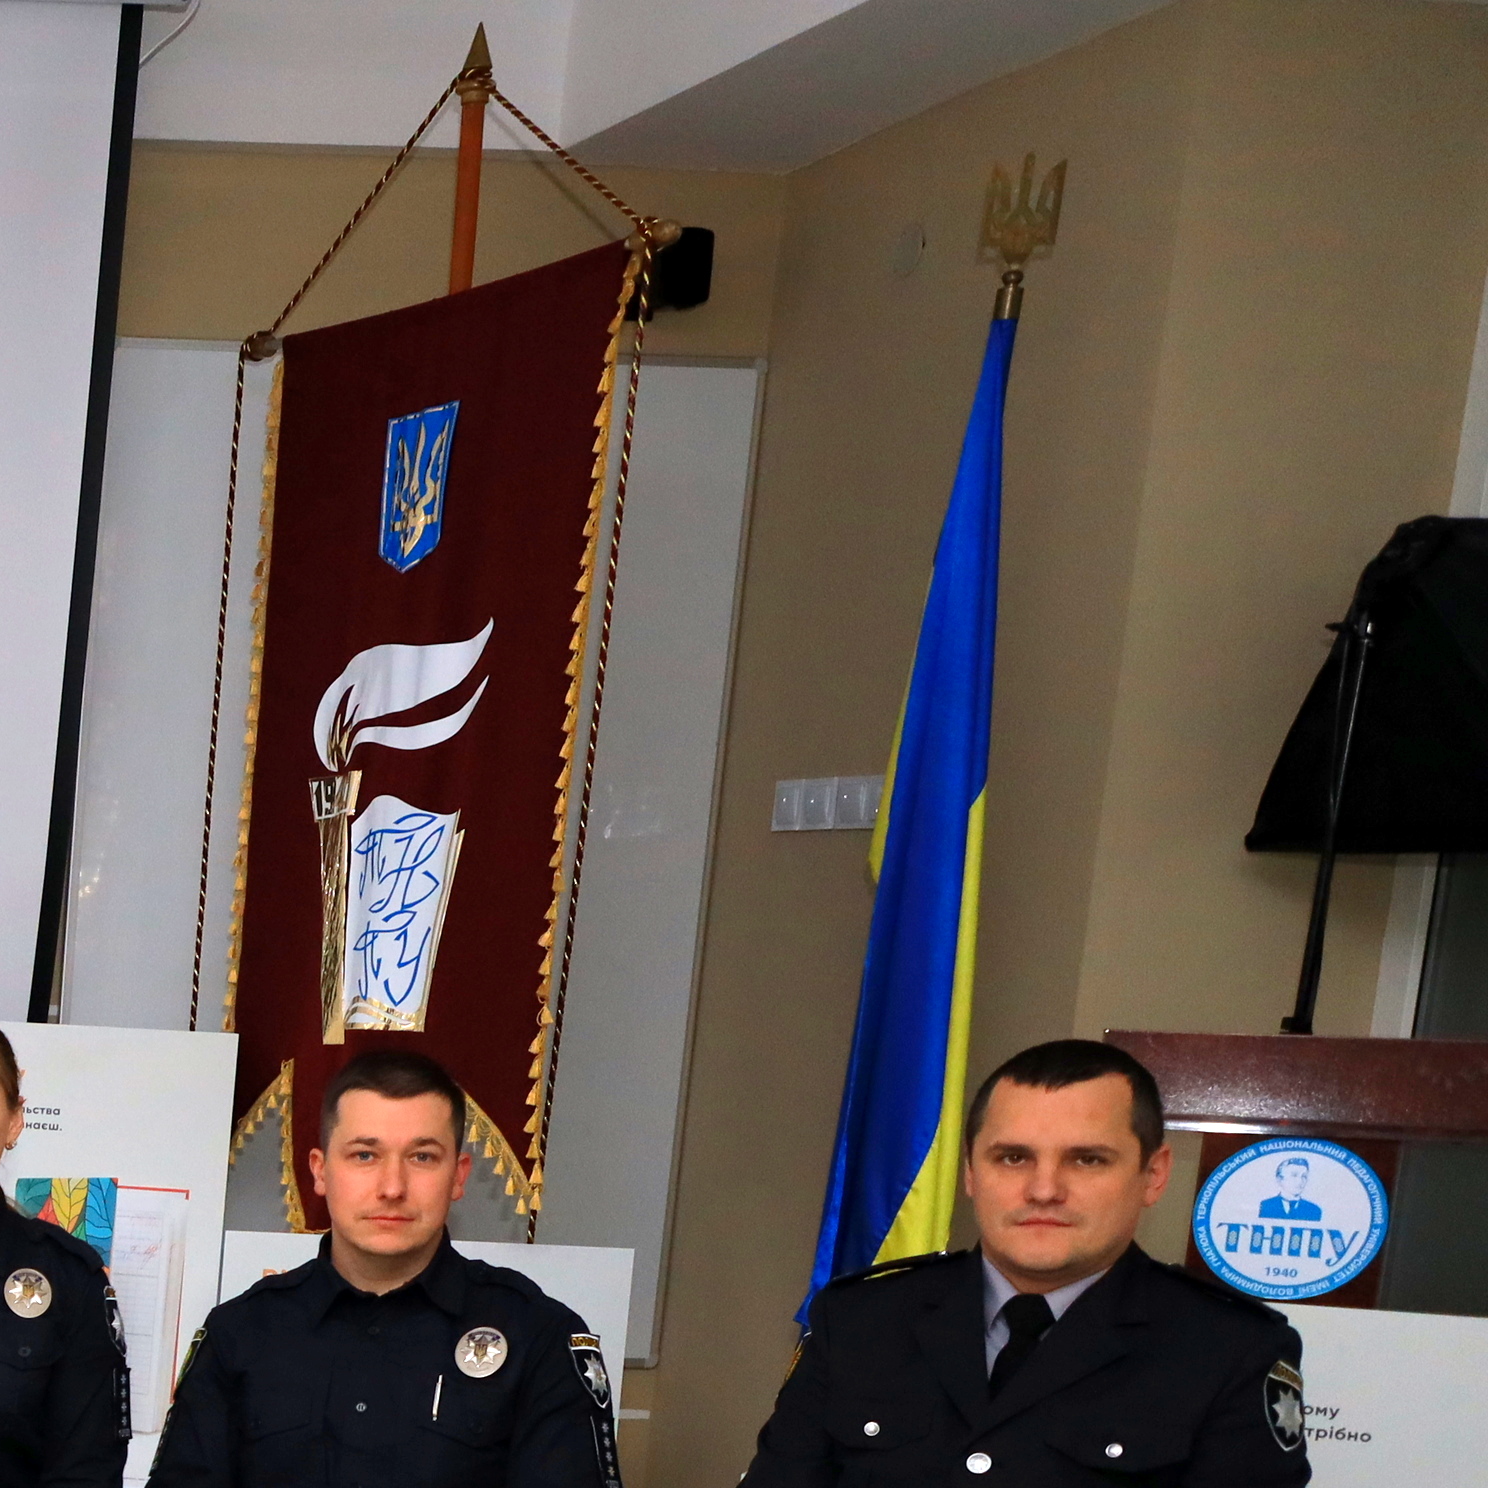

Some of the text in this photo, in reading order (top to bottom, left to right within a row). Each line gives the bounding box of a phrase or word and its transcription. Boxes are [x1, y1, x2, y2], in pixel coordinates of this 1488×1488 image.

[22, 1106, 61, 1116] ьства
[23, 1121, 63, 1132] наєш.
[1216, 1222, 1360, 1268] ТНПУ
[1264, 1266, 1298, 1279] 1940
[1305, 1426, 1372, 1444] трібно
